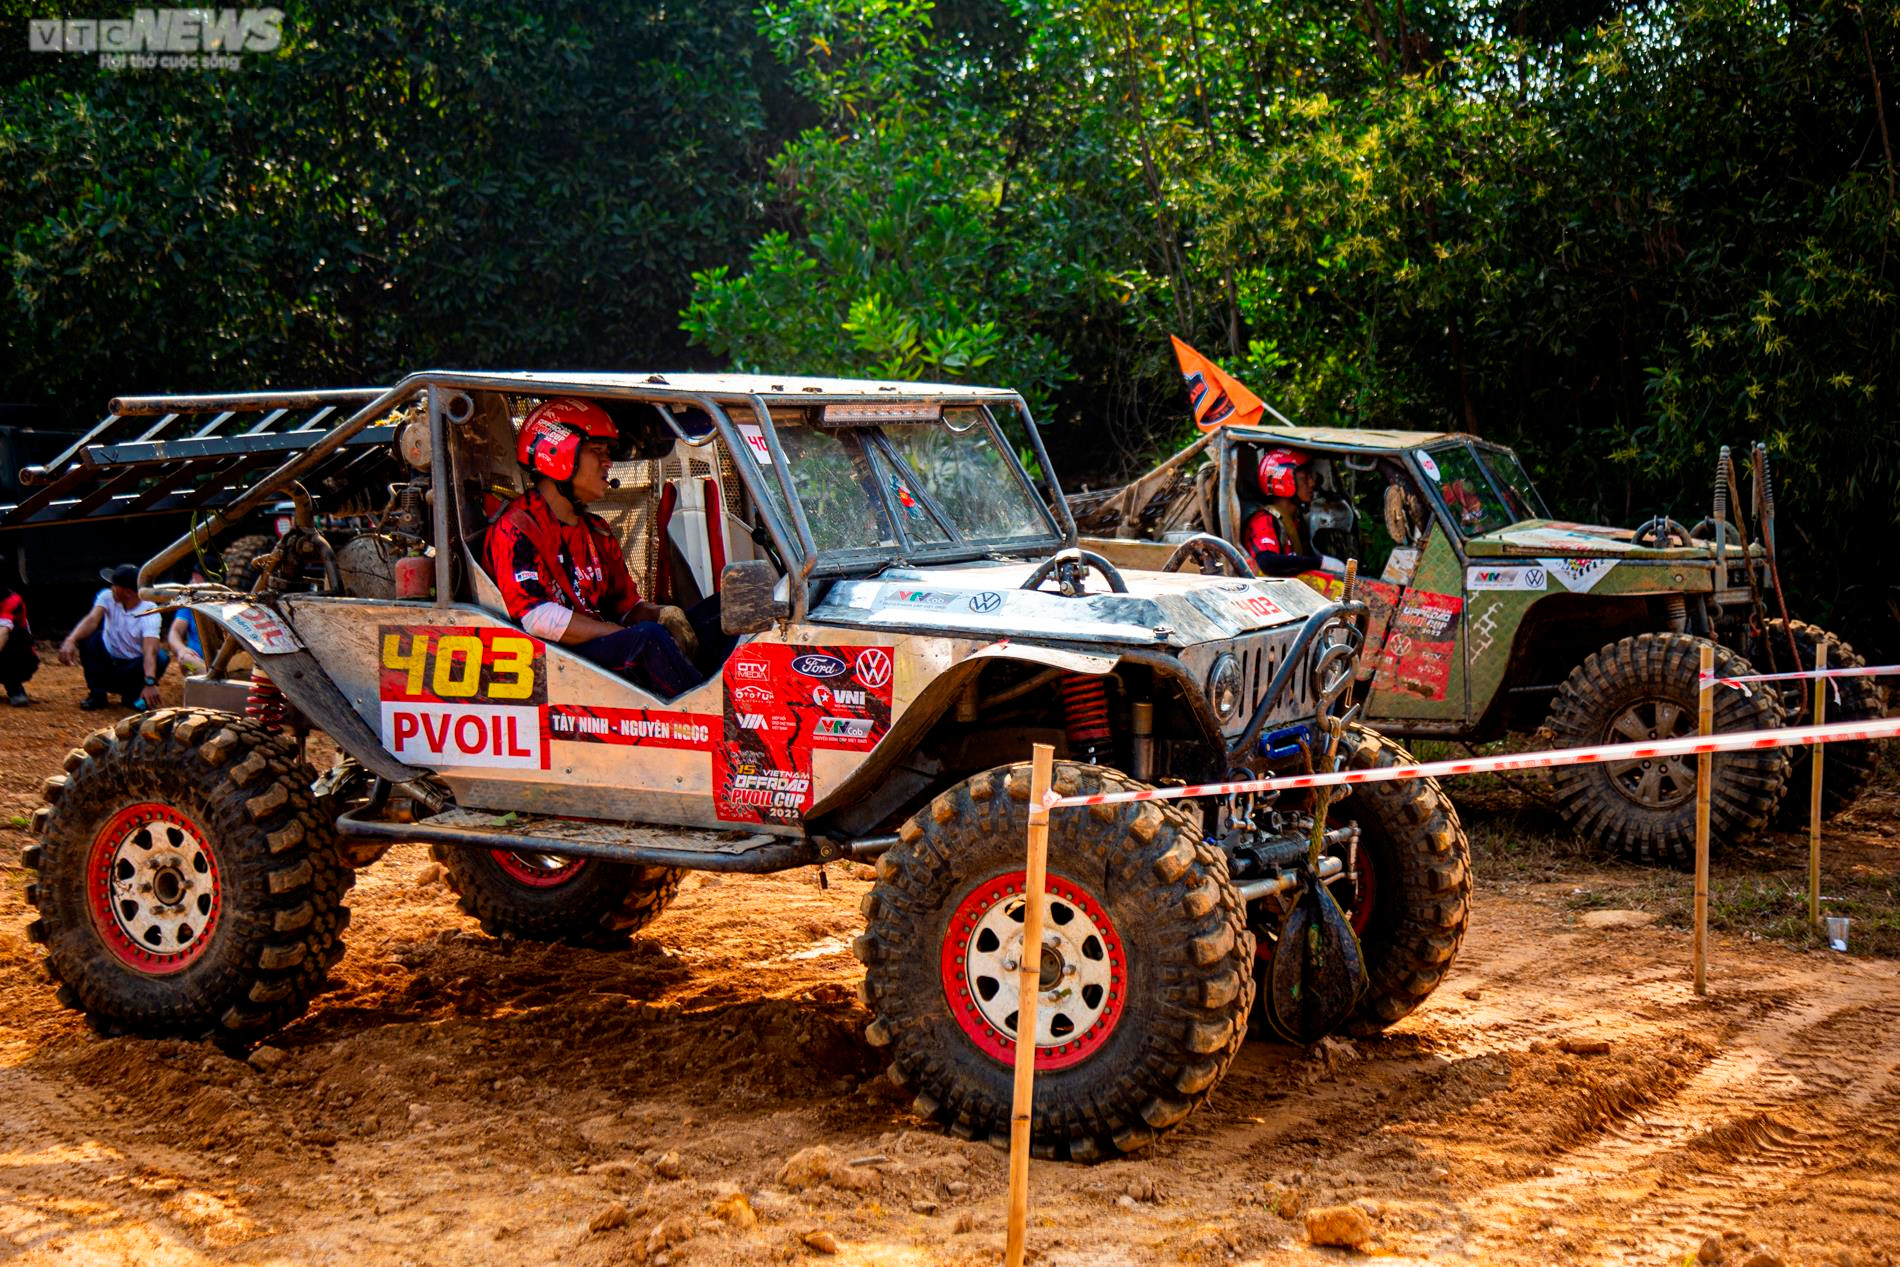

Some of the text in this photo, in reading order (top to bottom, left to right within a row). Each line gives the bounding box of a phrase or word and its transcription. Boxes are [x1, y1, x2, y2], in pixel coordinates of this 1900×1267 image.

[1238, 596, 1281, 617] 403
[383, 633, 535, 699] 403
[801, 657, 835, 675] Ford
[833, 689, 866, 705] VNI
[552, 713, 575, 732] TÂY
[579, 717, 608, 735] NINH
[393, 712, 531, 757] PVOIL
[738, 764, 756, 775] 15
[763, 769, 810, 780] VIETNAM
[734, 774, 810, 793] OFFROAD
[731, 788, 806, 808] PVOIL CUP
[769, 808, 799, 819] 2022
